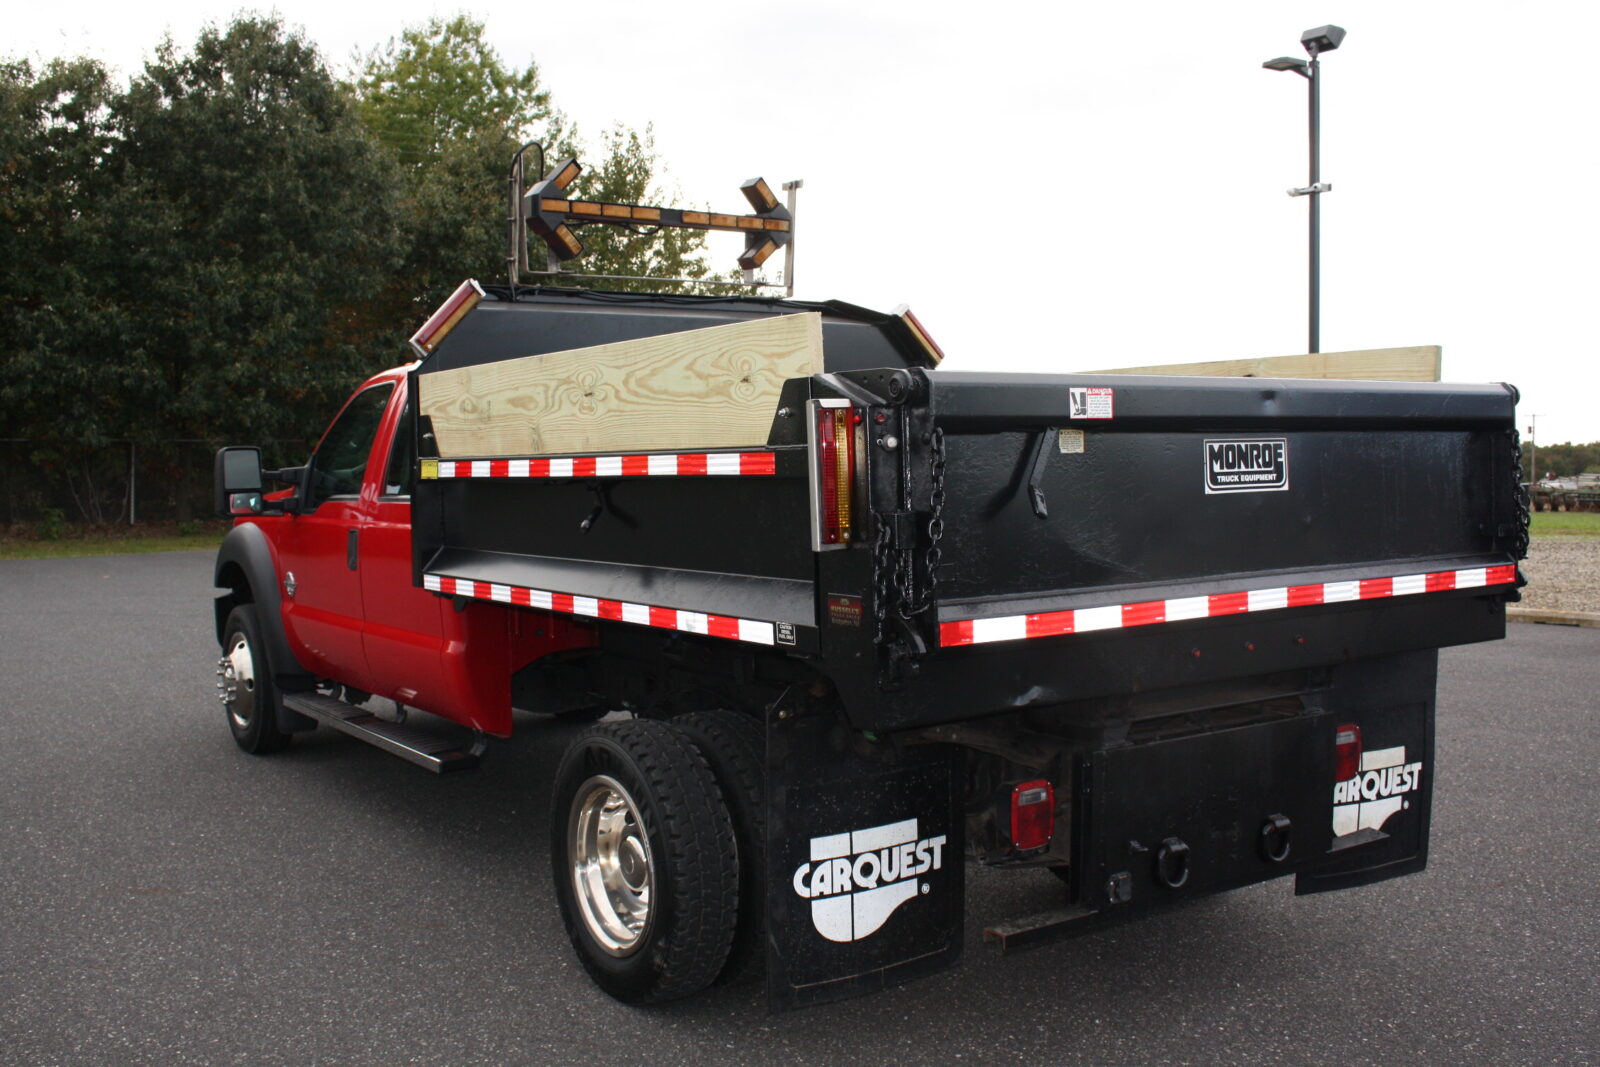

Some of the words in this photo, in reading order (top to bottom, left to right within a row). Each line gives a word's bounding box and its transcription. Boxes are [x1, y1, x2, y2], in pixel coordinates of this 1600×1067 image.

[1208, 443, 1283, 471] MONROE
[1216, 475, 1240, 483] TRUCK
[1241, 474, 1277, 482] EQUIPMENT
[1333, 762, 1422, 804] ARQUEST
[793, 835, 947, 898] CARQUEST
